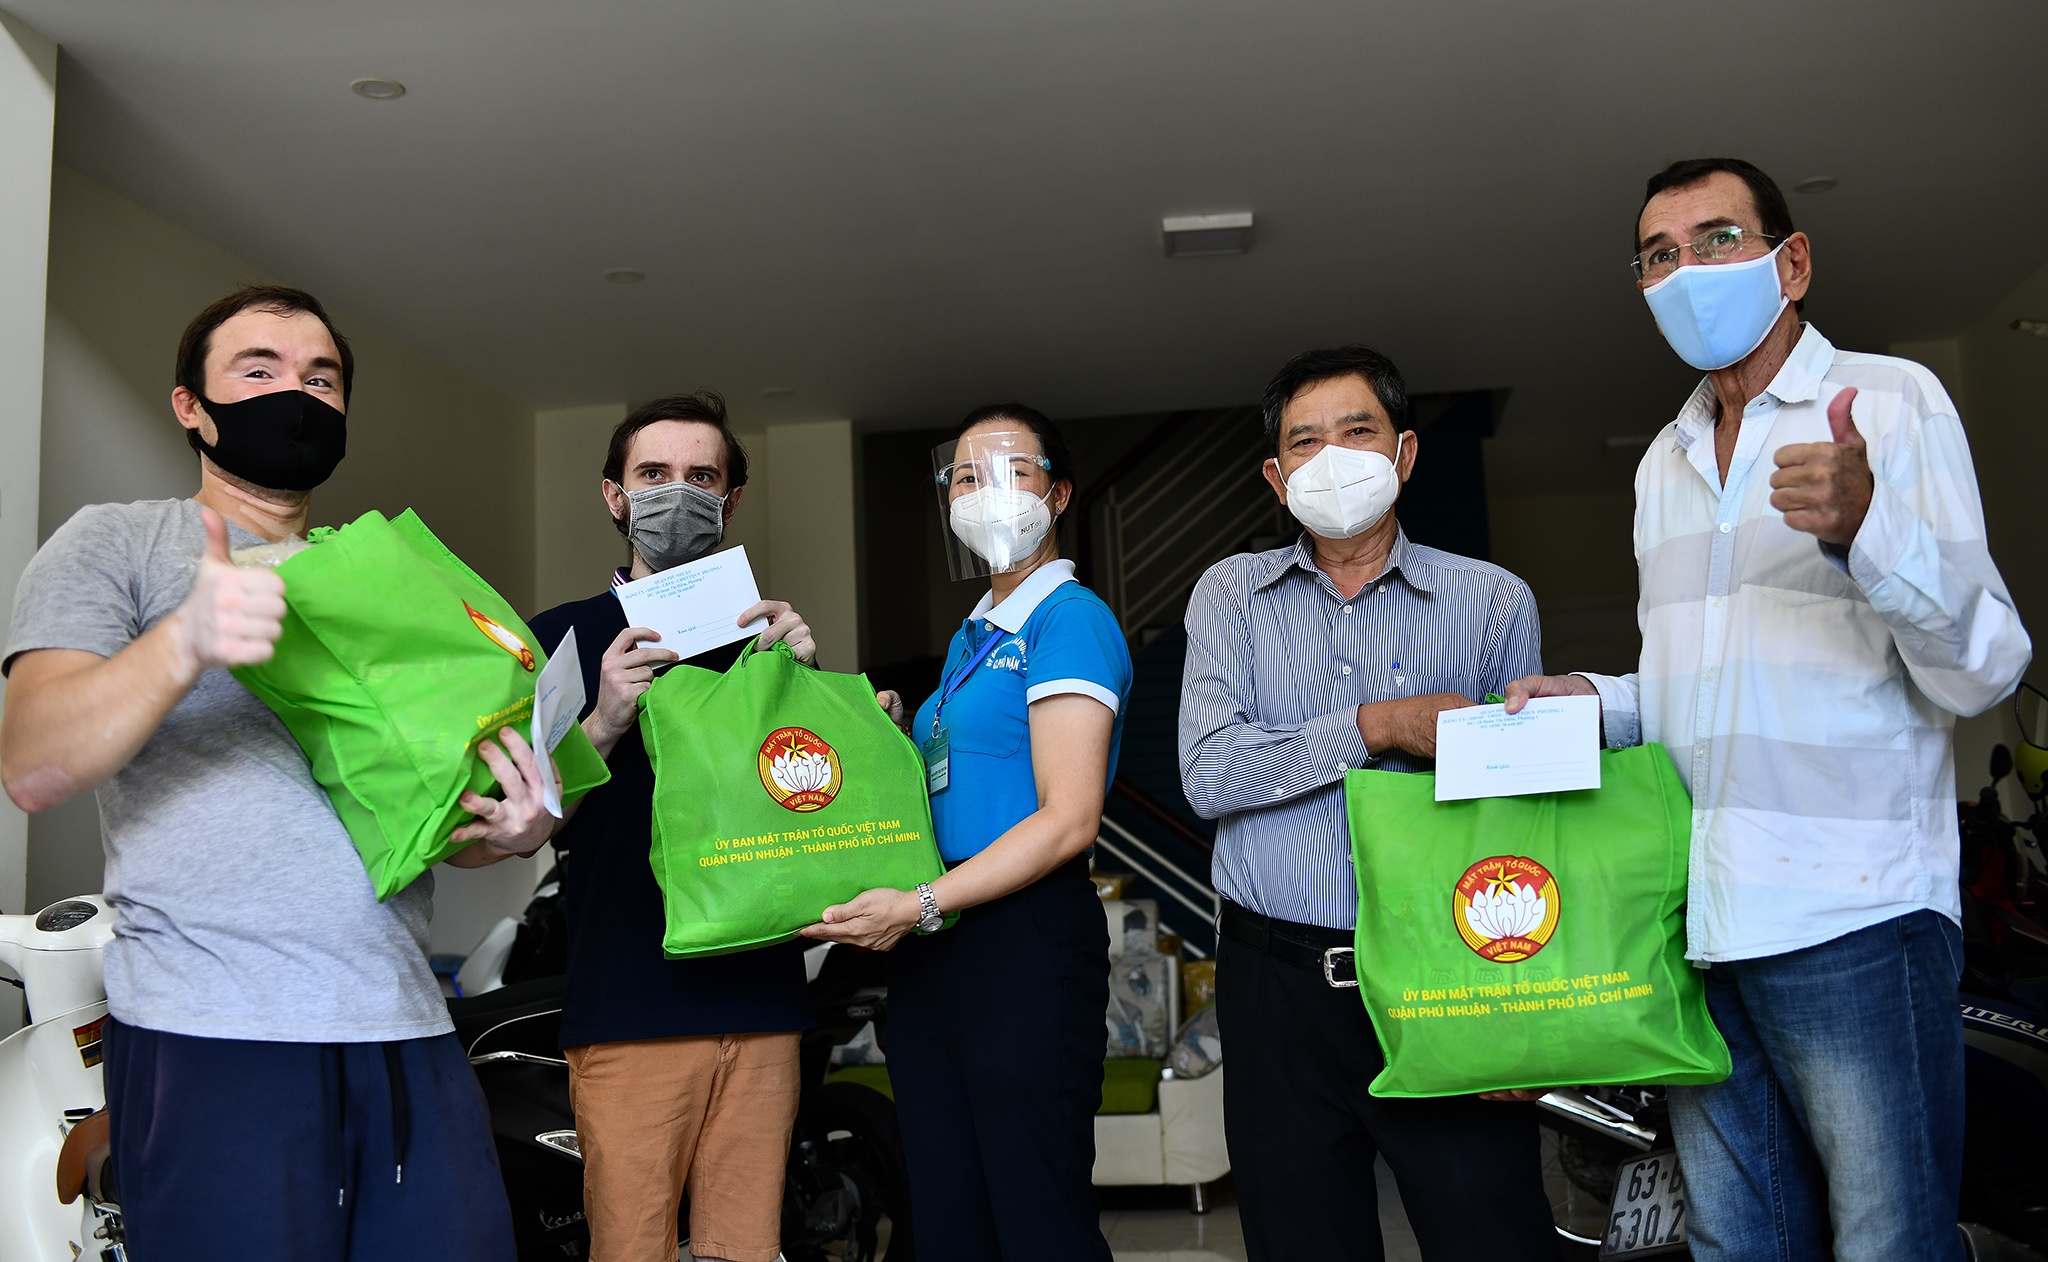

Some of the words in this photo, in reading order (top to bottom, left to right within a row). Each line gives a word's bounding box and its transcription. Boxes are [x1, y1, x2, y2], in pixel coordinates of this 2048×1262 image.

[765, 739, 778, 754] MẶT
[803, 734, 823, 748] QUỐC
[789, 794, 807, 806] VIỆT
[808, 794, 825, 803] NAM
[699, 853, 728, 868] QUẬN
[730, 850, 754, 863] PHÚ
[755, 845, 794, 860] NHUẬN
[801, 841, 837, 854] THÀNH
[838, 835, 860, 850] PHỐ
[861, 834, 876, 847] HỒ
[877, 832, 894, 845] CHÍ
[895, 831, 920, 843] MINH
[715, 838, 730, 851] ỦY
[732, 836, 756, 849] BAN
[757, 832, 780, 846] MẶT
[782, 828, 810, 842] TRẬN
[826, 822, 855, 837] QUỐC
[855, 820, 877, 834] VIỆT
[878, 819, 901, 830] NAM
[1462, 872, 1478, 890] MẶT
[1477, 861, 1501, 874] TRẬN
[1517, 861, 1542, 877] QUỐC
[1486, 941, 1508, 955] VIỆT
[1510, 941, 1532, 951] NAM
[1387, 1005, 1416, 1021] QUẬN
[1418, 1004, 1444, 1018] PHÚ
[1446, 1002, 1491, 1018] NHUẬN
[1501, 998, 1545, 1013] THÀNH
[1547, 992, 1575, 1010] PHỐ
[1577, 990, 1597, 1007] HỒ
[1599, 987, 1622, 1004] CHÍ
[1623, 983, 1653, 999] MINH
[1403, 987, 1419, 1002] ỦY
[1421, 989, 1447, 1001] BAN
[1449, 985, 1474, 1001] MẶT
[1477, 983, 1511, 999] TRẬN
[1533, 976, 1569, 994] QUỐC
[1570, 974, 1600, 990] VIỆT
[1601, 970, 1630, 985] NAM
[1960, 1004, 2036, 1032] ITER
[1627, 1156, 1684, 1202] 63-B
[1608, 1199, 1685, 1254] 530.2
